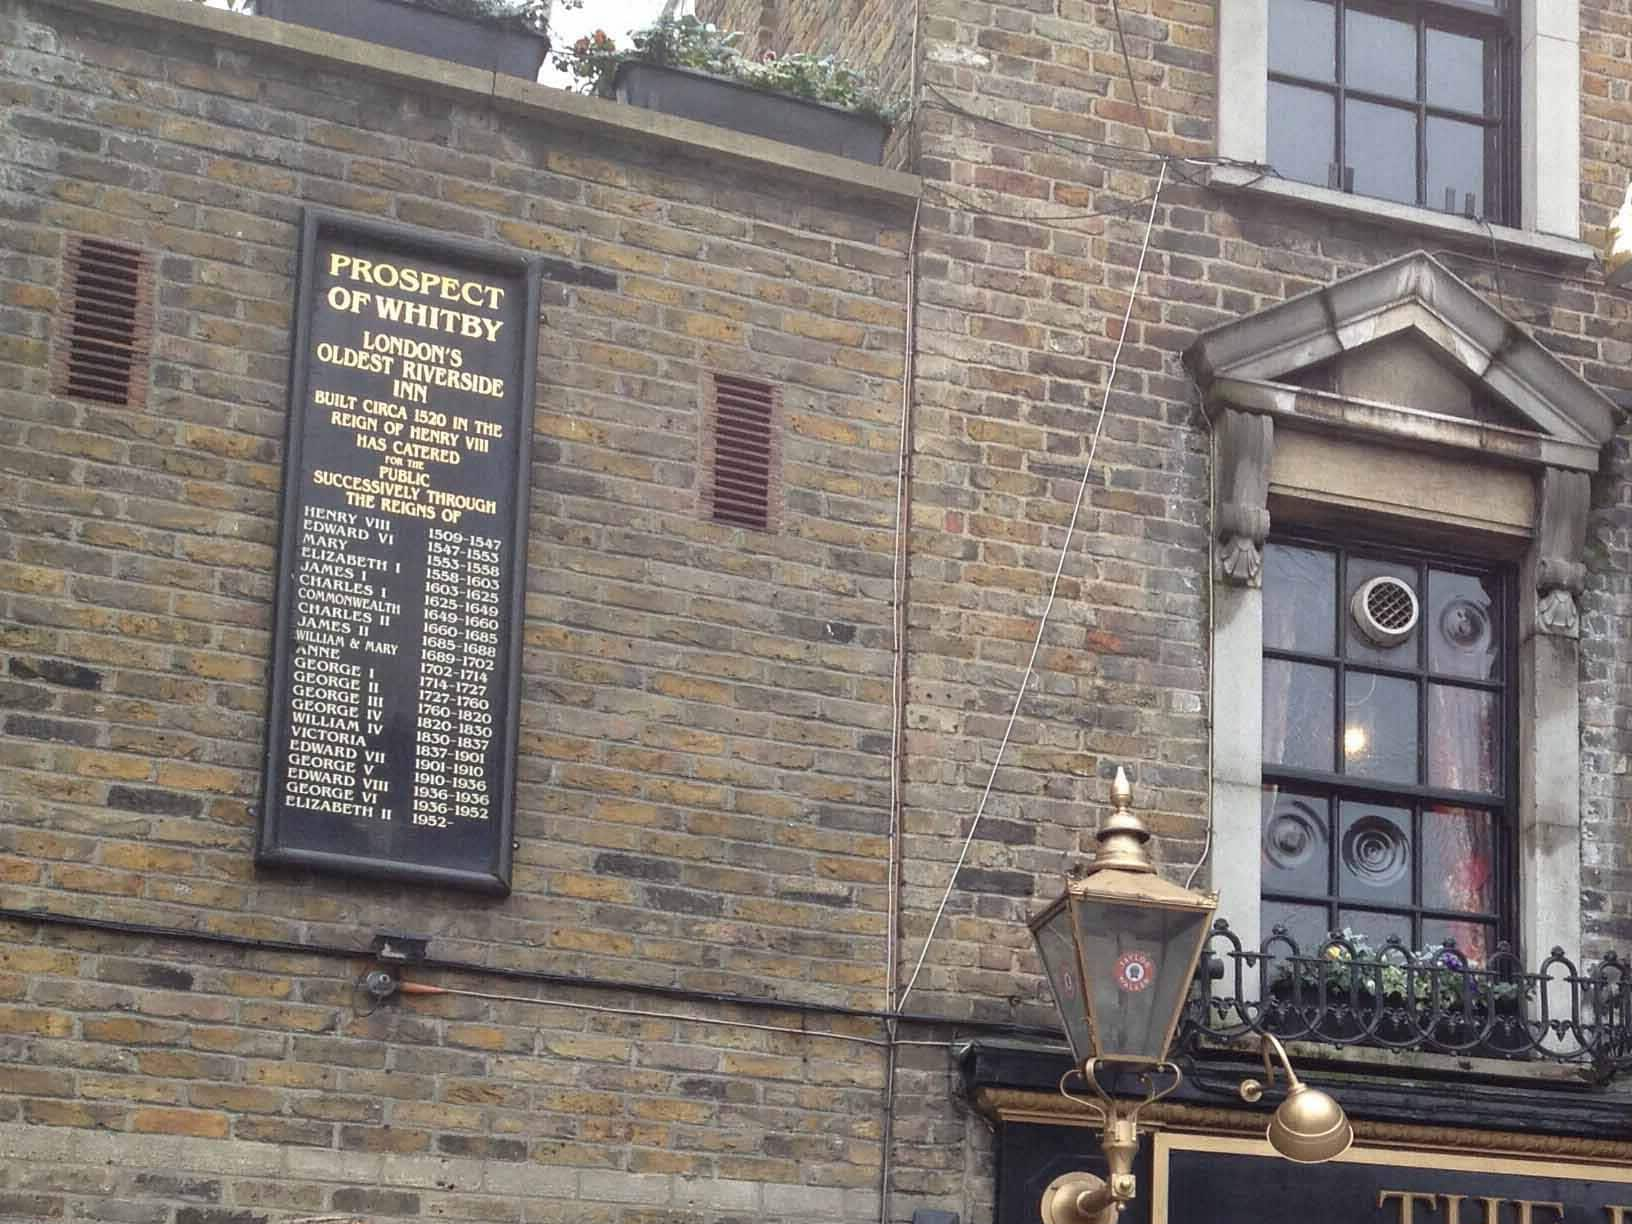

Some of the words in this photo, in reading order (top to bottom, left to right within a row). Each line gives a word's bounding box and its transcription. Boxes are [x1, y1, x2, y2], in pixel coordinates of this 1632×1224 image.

[329, 253, 505, 310] PROSPECT
[327, 286, 371, 314] OF
[375, 295, 504, 342] WHITBY
[363, 331, 463, 368] LONDON'S
[317, 343, 394, 376] OLDEST
[402, 360, 505, 398] RIVERSIDE
[393, 380, 428, 403] INN
[314, 390, 357, 410] BUILT
[363, 400, 407, 420] CIRCA
[415, 409, 447, 428] 1520
[453, 416, 469, 431] IN
[475, 420, 503, 438] THE
[331, 411, 378, 432] REIGN
[384, 420, 404, 437] OF
[410, 425, 458, 447] HENRY
[465, 436, 489, 453] VIII
[356, 433, 387, 452] HAS
[393, 440, 460, 465] CATERED
[385, 455, 404, 467] FOR
[407, 459, 424, 470] THE
[313, 470, 420, 500] SUCCESSIVELY
[426, 490, 497, 514] THROUGH
[379, 465, 430, 488] PUBLIC
[346, 491, 375, 509] THE
[381, 499, 436, 521] REIGNS
[441, 509, 462, 523] OF
[304, 506, 357, 525] HENRY
[366, 517, 390, 531] VIII
[429, 528, 501, 550] 1509-1547
[304, 520, 368, 540] EDWARD
[379, 533, 394, 545] VI
[428, 541, 499, 563] 1547-1553
[302, 547, 387, 571] ELIZABETH
[396, 562, 400, 574] I
[426, 568, 500, 590] 1558-1603
[303, 534, 348, 550] MARY
[427, 555, 500, 577] 1553-1558
[299, 574, 373, 596] CHARLES
[382, 588, 386, 598] I
[424, 596, 498, 617] 1625-1649
[300, 561, 354, 580] JAMES
[362, 571, 367, 582] I
[426, 582, 498, 604] 1603-1625
[298, 588, 400, 615] COMMONWEALTH
[424, 610, 498, 630] 1649-1660
[298, 602, 372, 624] CHARLES
[380, 616, 390, 626] II
[424, 622, 498, 644] 1660-1685
[296, 630, 345, 647] WILLIAM
[350, 638, 360, 650] &
[365, 642, 399, 656] MARY
[422, 650, 494, 671] 1689-1702
[297, 616, 351, 634] JAMES
[359, 626, 369, 637] II
[422, 636, 496, 657] 1685-1688
[294, 658, 361, 677] GEORGE
[370, 668, 374, 679] I
[420, 676, 486, 696] 1714-1727
[296, 646, 340, 660] ANNE
[420, 663, 488, 684] 1702-1714
[292, 685, 360, 704] GEORGE
[368, 696, 383, 708] III
[418, 704, 492, 724] 1760-1820
[294, 671, 360, 690] GEORGE
[369, 682, 379, 694] II
[420, 690, 489, 710] 1727-1760
[292, 698, 359, 718] GEORGE
[368, 709, 382, 721] IV
[418, 717, 492, 738] 1820-1830
[292, 712, 360, 732] WILLIAM
[368, 723, 383, 735] IV
[417, 731, 489, 751] 1830-1837
[290, 740, 358, 760] EDWARD
[365, 751, 384, 764] VII
[416, 758, 484, 777] 1901-1910
[292, 726, 366, 747] VICTORIA
[416, 744, 484, 764] 1837-1901
[288, 753, 356, 773] GEORGE
[364, 764, 374, 776] V
[414, 772, 486, 791] 1910-1936
[288, 767, 355, 787] EDWARD
[363, 778, 388, 792] VIII
[414, 786, 490, 805] 1936-1936
[286, 781, 354, 800] GEORGE
[362, 792, 376, 804] VI
[413, 800, 488, 818] 1936-1952
[286, 795, 373, 818] ELIZABETH
[382, 808, 392, 820] II
[412, 813, 454, 828] 1952-
